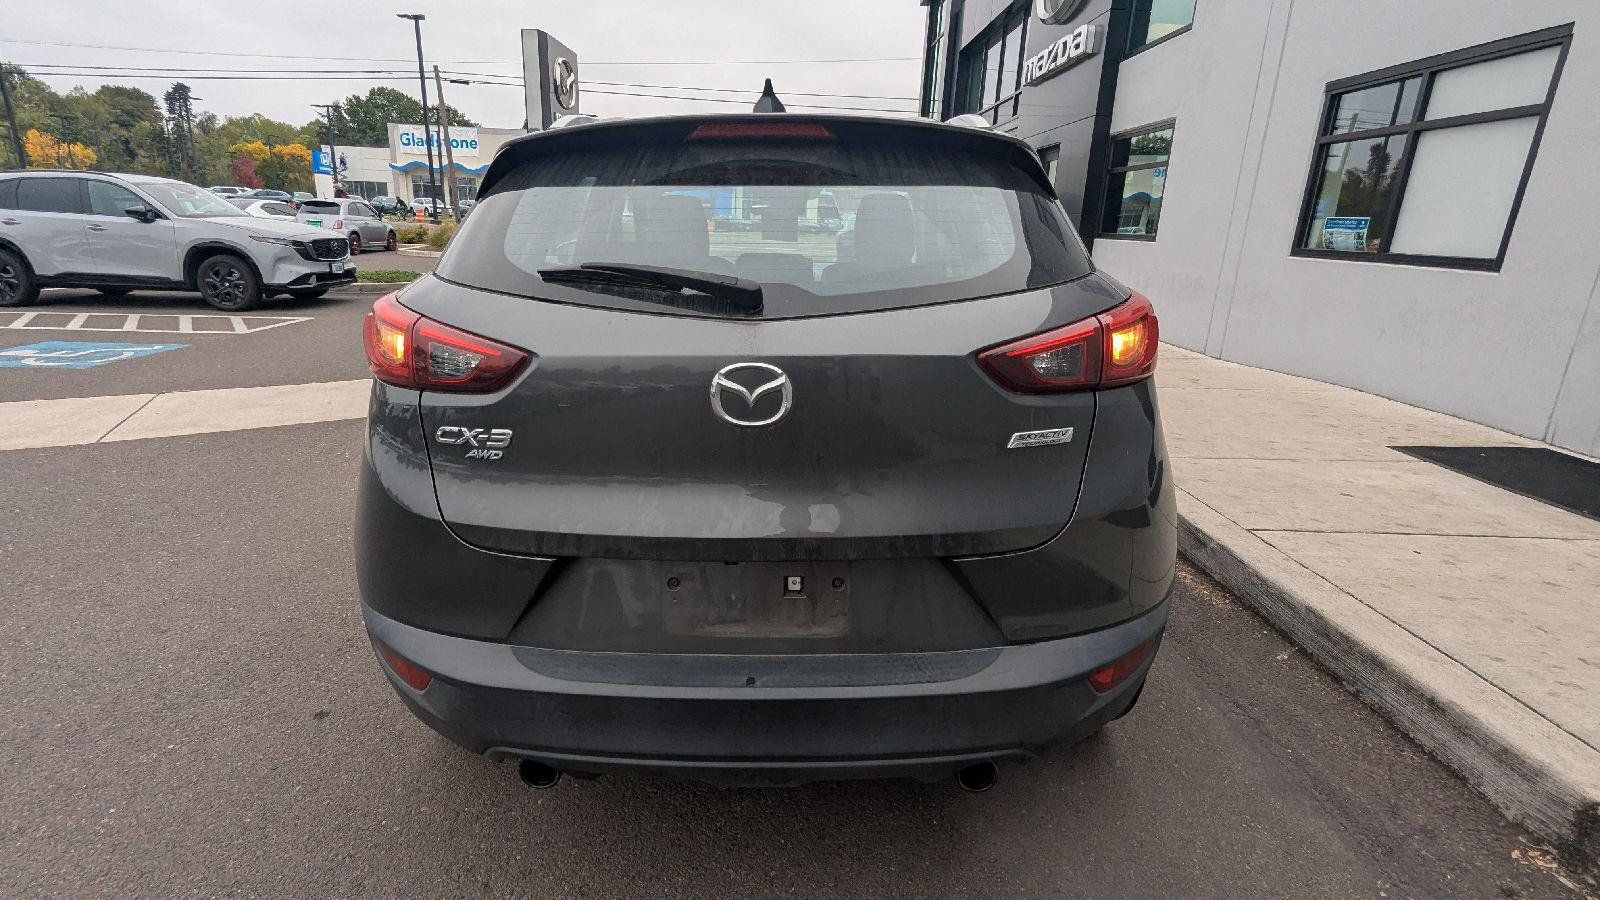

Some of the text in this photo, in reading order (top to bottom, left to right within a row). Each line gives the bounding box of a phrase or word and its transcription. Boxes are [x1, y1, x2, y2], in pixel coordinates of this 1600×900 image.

[400, 132, 478, 149] Gladone
[435, 426, 513, 448] CX-3
[1016, 429, 1070, 441] SKYACTIV
[465, 449, 503, 460] AWD
